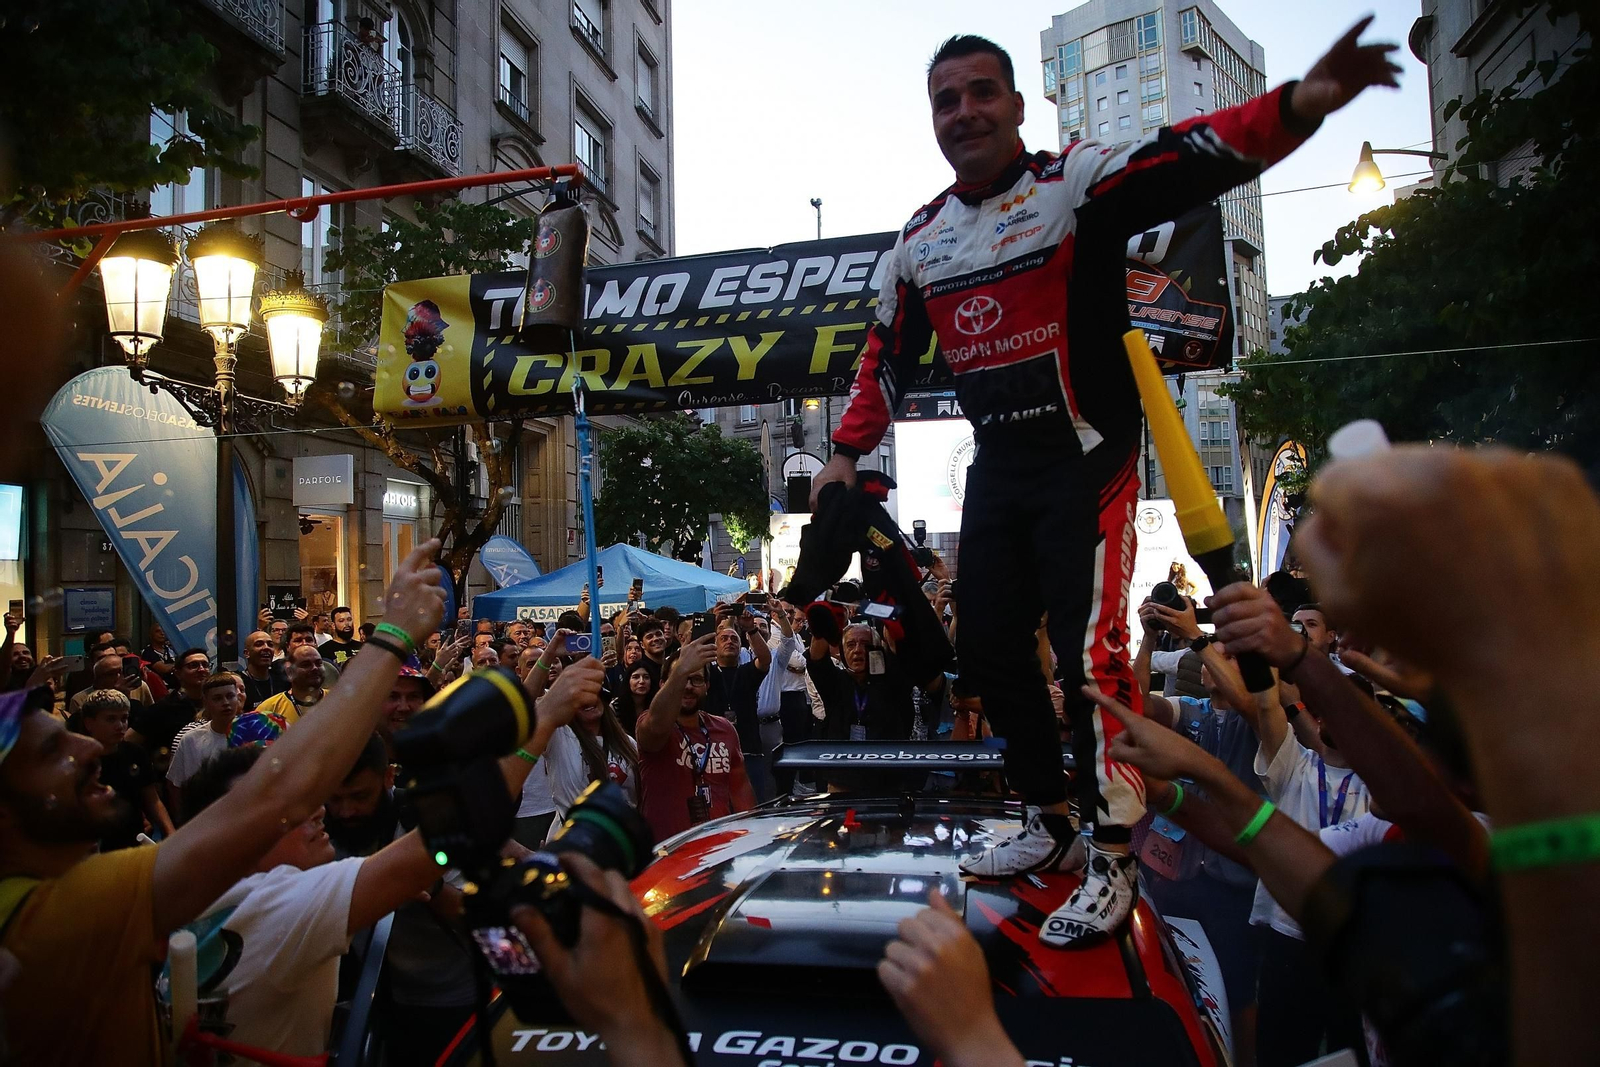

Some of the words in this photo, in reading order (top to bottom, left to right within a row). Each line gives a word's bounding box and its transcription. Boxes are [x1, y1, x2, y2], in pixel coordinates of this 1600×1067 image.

[907, 211, 928, 231] OMP
[932, 281, 967, 294] TOYOTA
[969, 271, 1003, 286] GAZOO
[1004, 256, 1045, 275] Racing
[483, 272, 690, 330] TMO
[1128, 304, 1219, 331] URENSE
[995, 322, 1060, 351] MOTOR
[508, 330, 785, 396] CRAZY
[299, 475, 342, 485] PARFOIS
[712, 1030, 920, 1066] GAZOO
